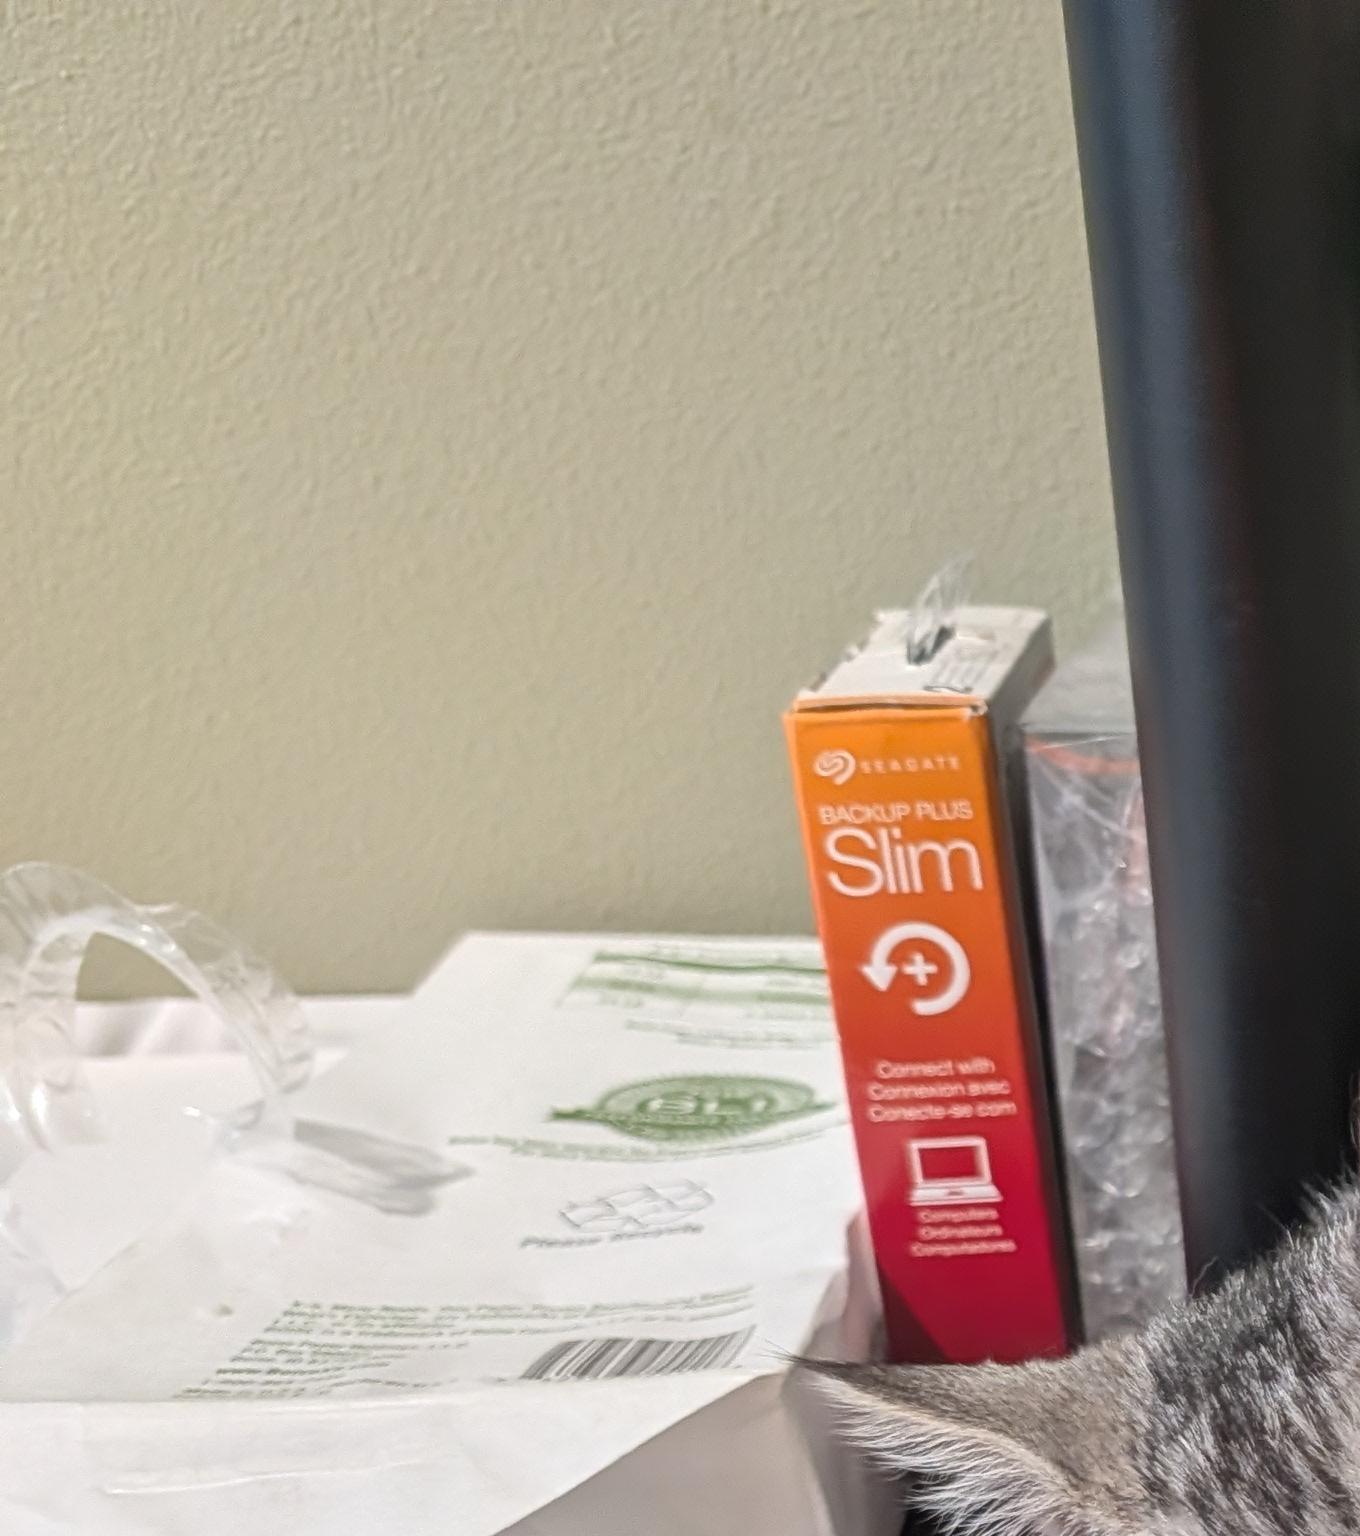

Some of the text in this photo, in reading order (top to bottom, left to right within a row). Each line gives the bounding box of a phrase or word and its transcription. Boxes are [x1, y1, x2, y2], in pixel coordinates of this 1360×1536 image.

[859, 756, 960, 774] SEAGATE
[819, 799, 974, 825] BACKUP PLUS
[825, 827, 983, 897] Slim
[876, 1057, 996, 1079] Connect with
[868, 1081, 966, 1100] Connexion
